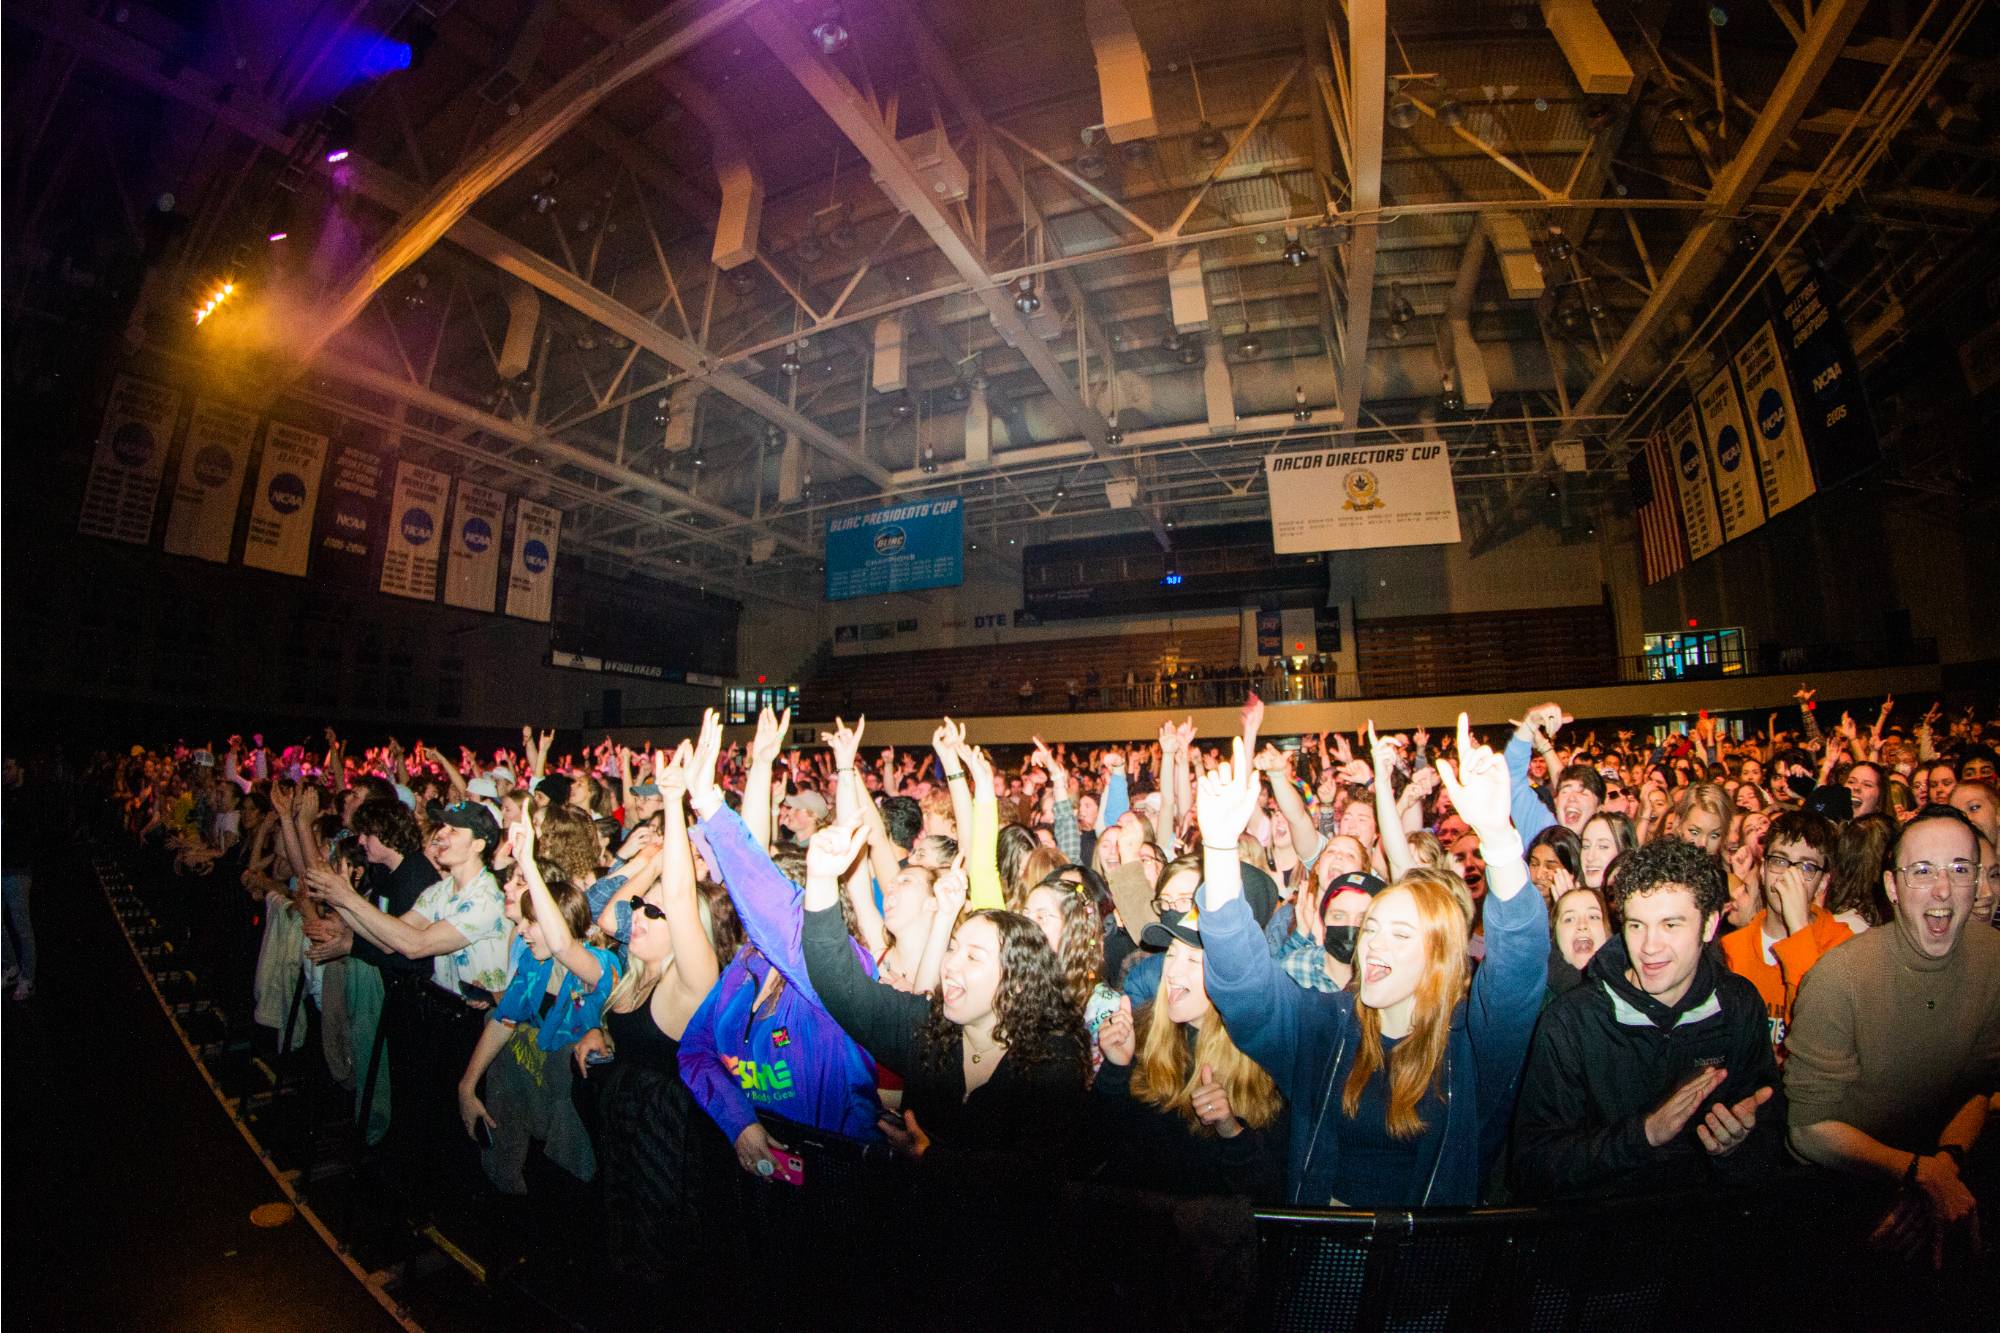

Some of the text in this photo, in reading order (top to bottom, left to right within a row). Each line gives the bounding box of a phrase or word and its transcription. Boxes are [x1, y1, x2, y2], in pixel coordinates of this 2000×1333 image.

[1812, 361, 1843, 393] NCAA
[1761, 407, 1785, 431] NCAA
[1273, 446, 1441, 472] NACDA DIRECTORS' CUP
[1720, 443, 1740, 465] NCAA
[272, 491, 304, 508] NCAA
[336, 512, 367, 531] NCAA
[830, 516, 861, 532] GLIAC
[932, 499, 958, 516] CUP
[403, 523, 432, 539] NCAA
[465, 532, 491, 546] NCAA
[876, 536, 904, 548] GLIAC
[525, 554, 548, 568] NCAA
[975, 613, 1006, 628] DTE
